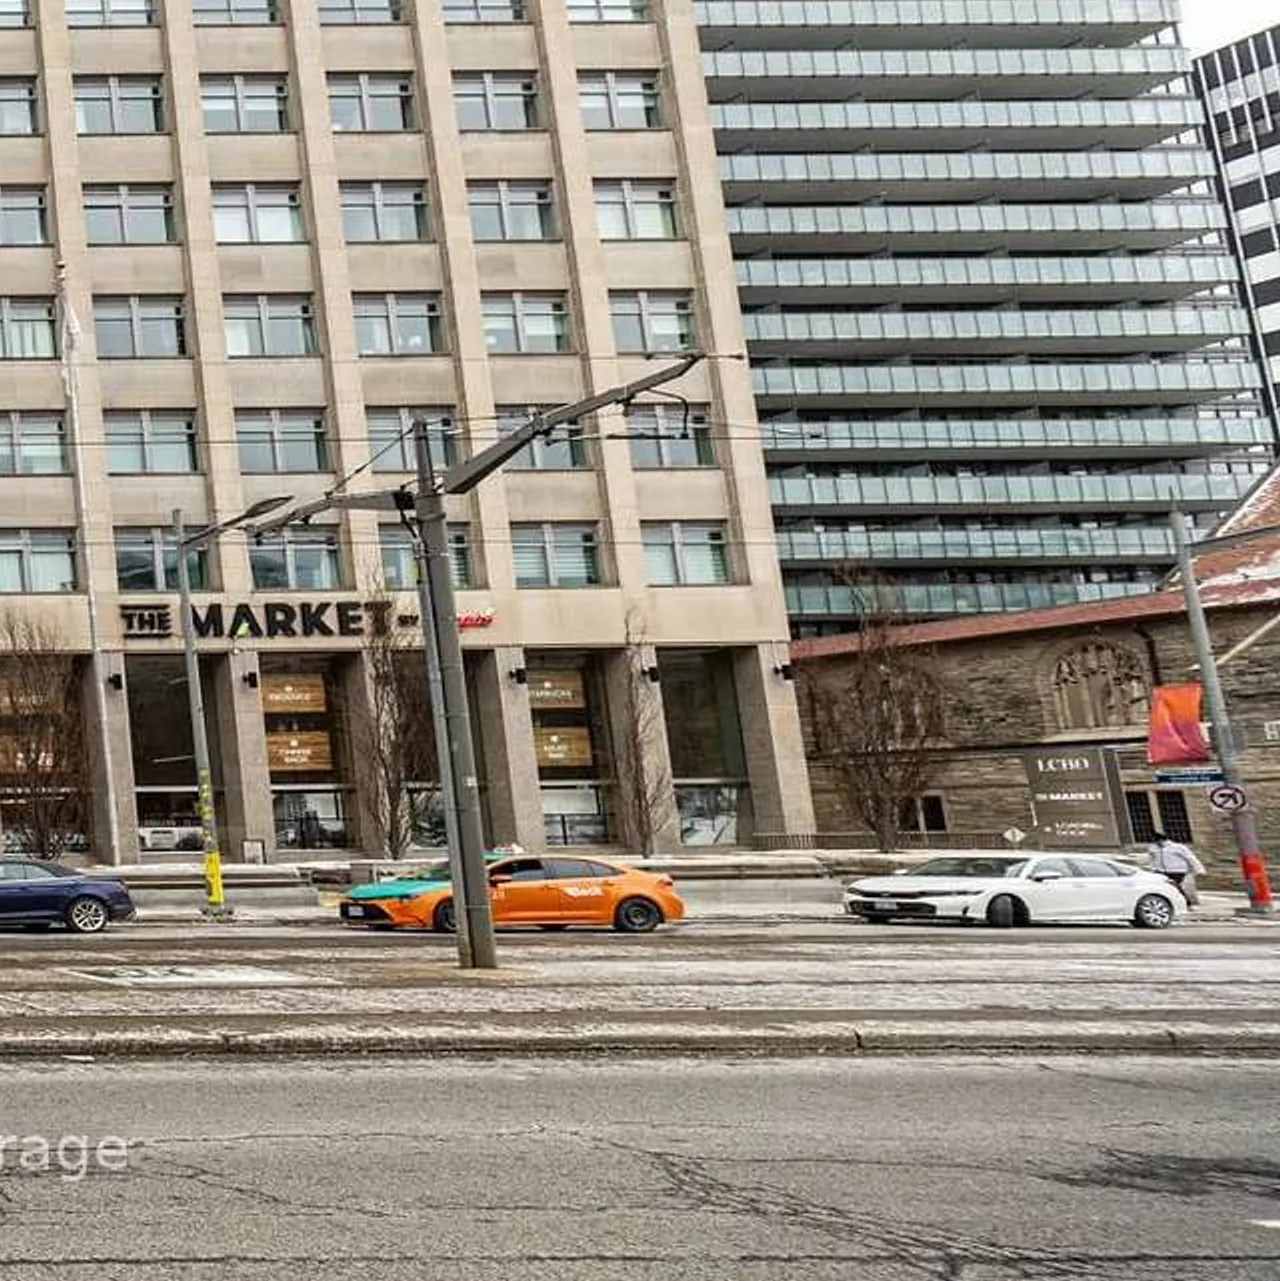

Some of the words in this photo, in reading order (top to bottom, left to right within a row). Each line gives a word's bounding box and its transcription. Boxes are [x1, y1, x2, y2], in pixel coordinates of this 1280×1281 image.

[121, 608, 171, 633] THE
[190, 601, 393, 638] MARKET
[1037, 758, 1090, 772] LCBO
